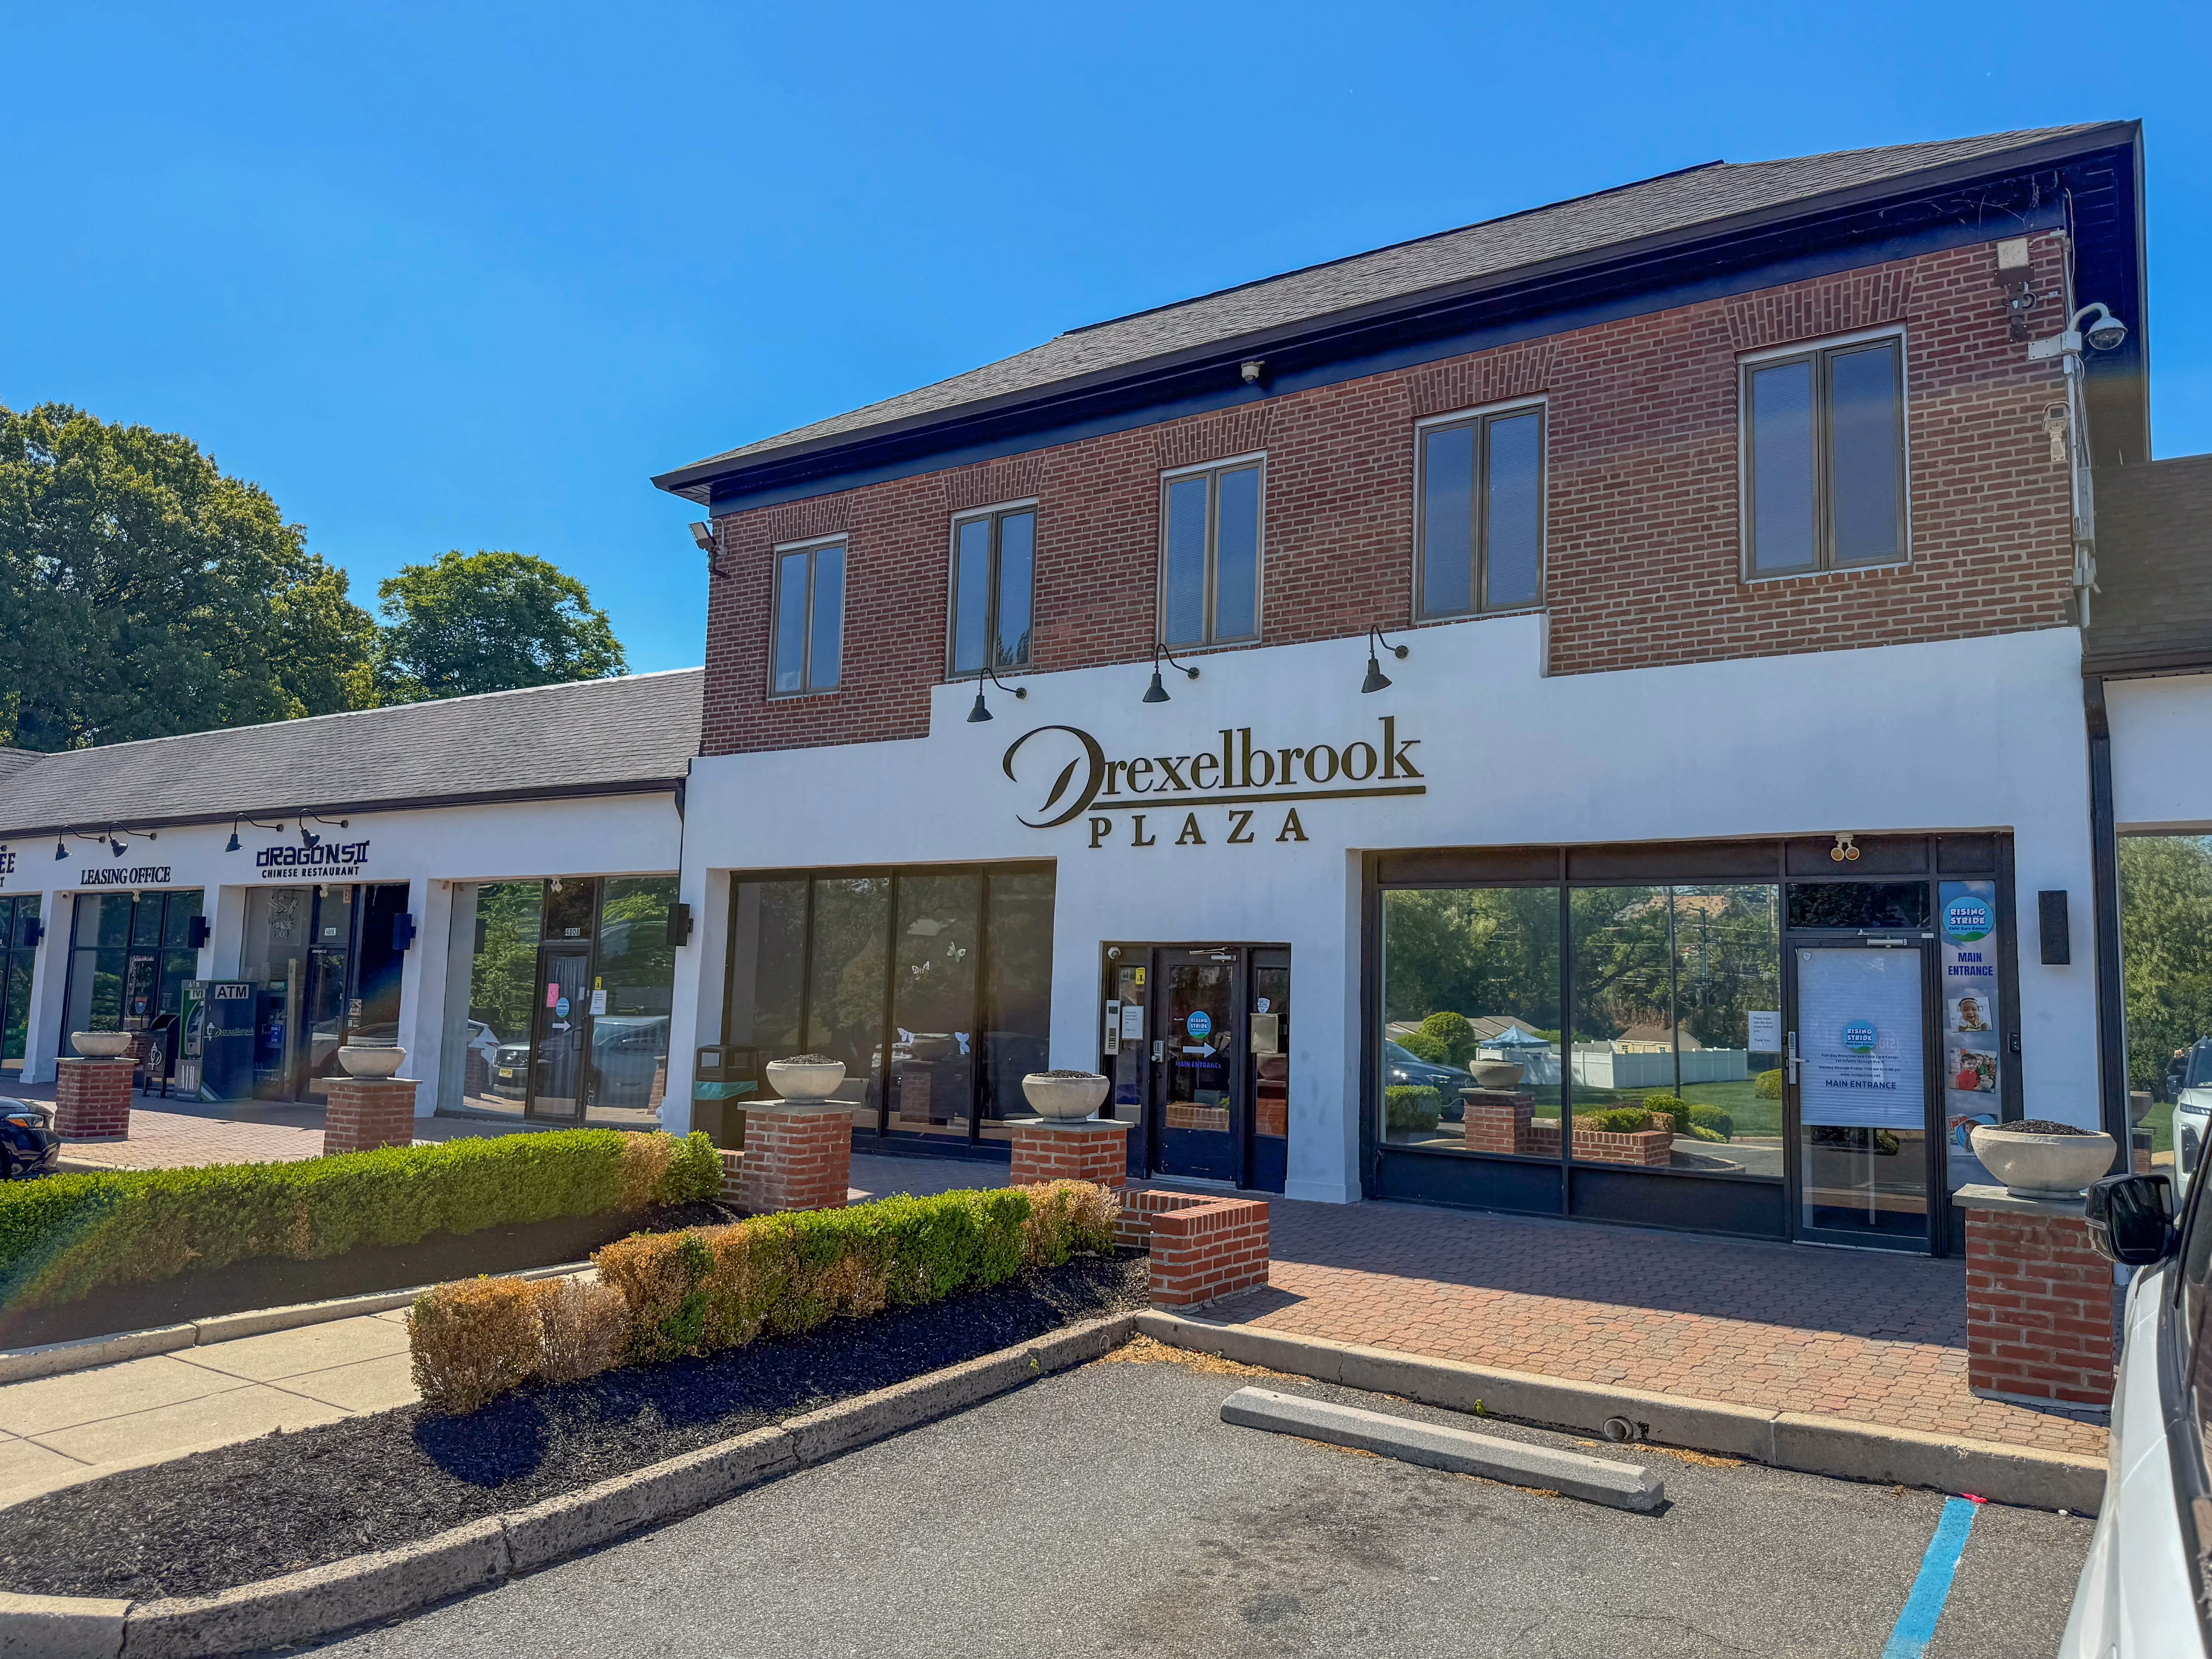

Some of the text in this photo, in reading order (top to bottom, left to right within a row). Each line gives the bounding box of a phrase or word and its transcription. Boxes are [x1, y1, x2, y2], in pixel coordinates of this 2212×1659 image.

[1002, 716, 1424, 828] Drexelbrook
[1088, 807, 1309, 848] PLAZA
[80, 866, 171, 884] LEASING OFFICE
[262, 866, 359, 878] CHINESE RESTAURANT
[566, 927, 580, 936] 4808
[1958, 952, 1982, 962] MAIN
[1948, 965, 1993, 976] ENTRANCE
[216, 986, 247, 998] ATM
[1850, 1080, 1896, 1089] ENTRANCE
